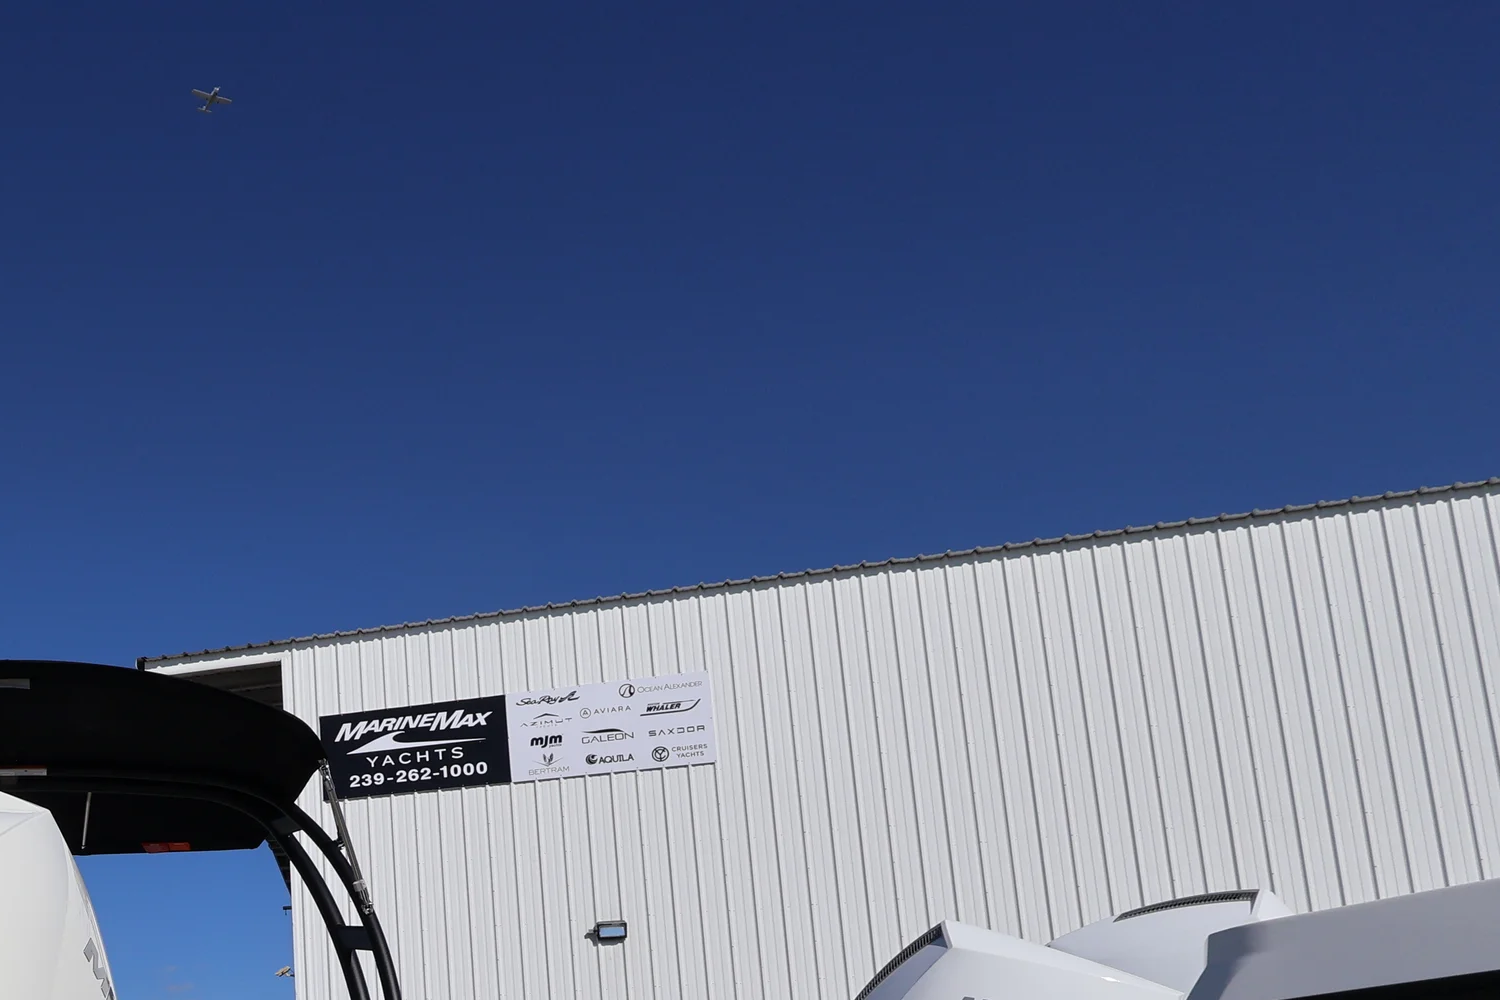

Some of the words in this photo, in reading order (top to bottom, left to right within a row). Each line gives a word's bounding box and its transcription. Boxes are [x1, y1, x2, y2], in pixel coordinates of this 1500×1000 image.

[637, 685, 663, 694] OCEAN
[663, 681, 703, 690] ALEXANDER
[593, 705, 632, 715] AVIARA
[646, 702, 681, 712] WHALER
[520, 717, 573, 727] AZIMUT
[648, 725, 706, 737] SAXDOR
[581, 732, 635, 745] GALEON
[671, 743, 708, 752] CRUISERS
[366, 747, 464, 768] YACHTS
[598, 753, 635, 764] AQUILA
[676, 751, 705, 759] YACHTS
[349, 761, 488, 788] 239-262-1000
[528, 766, 570, 776] BERTRAM
